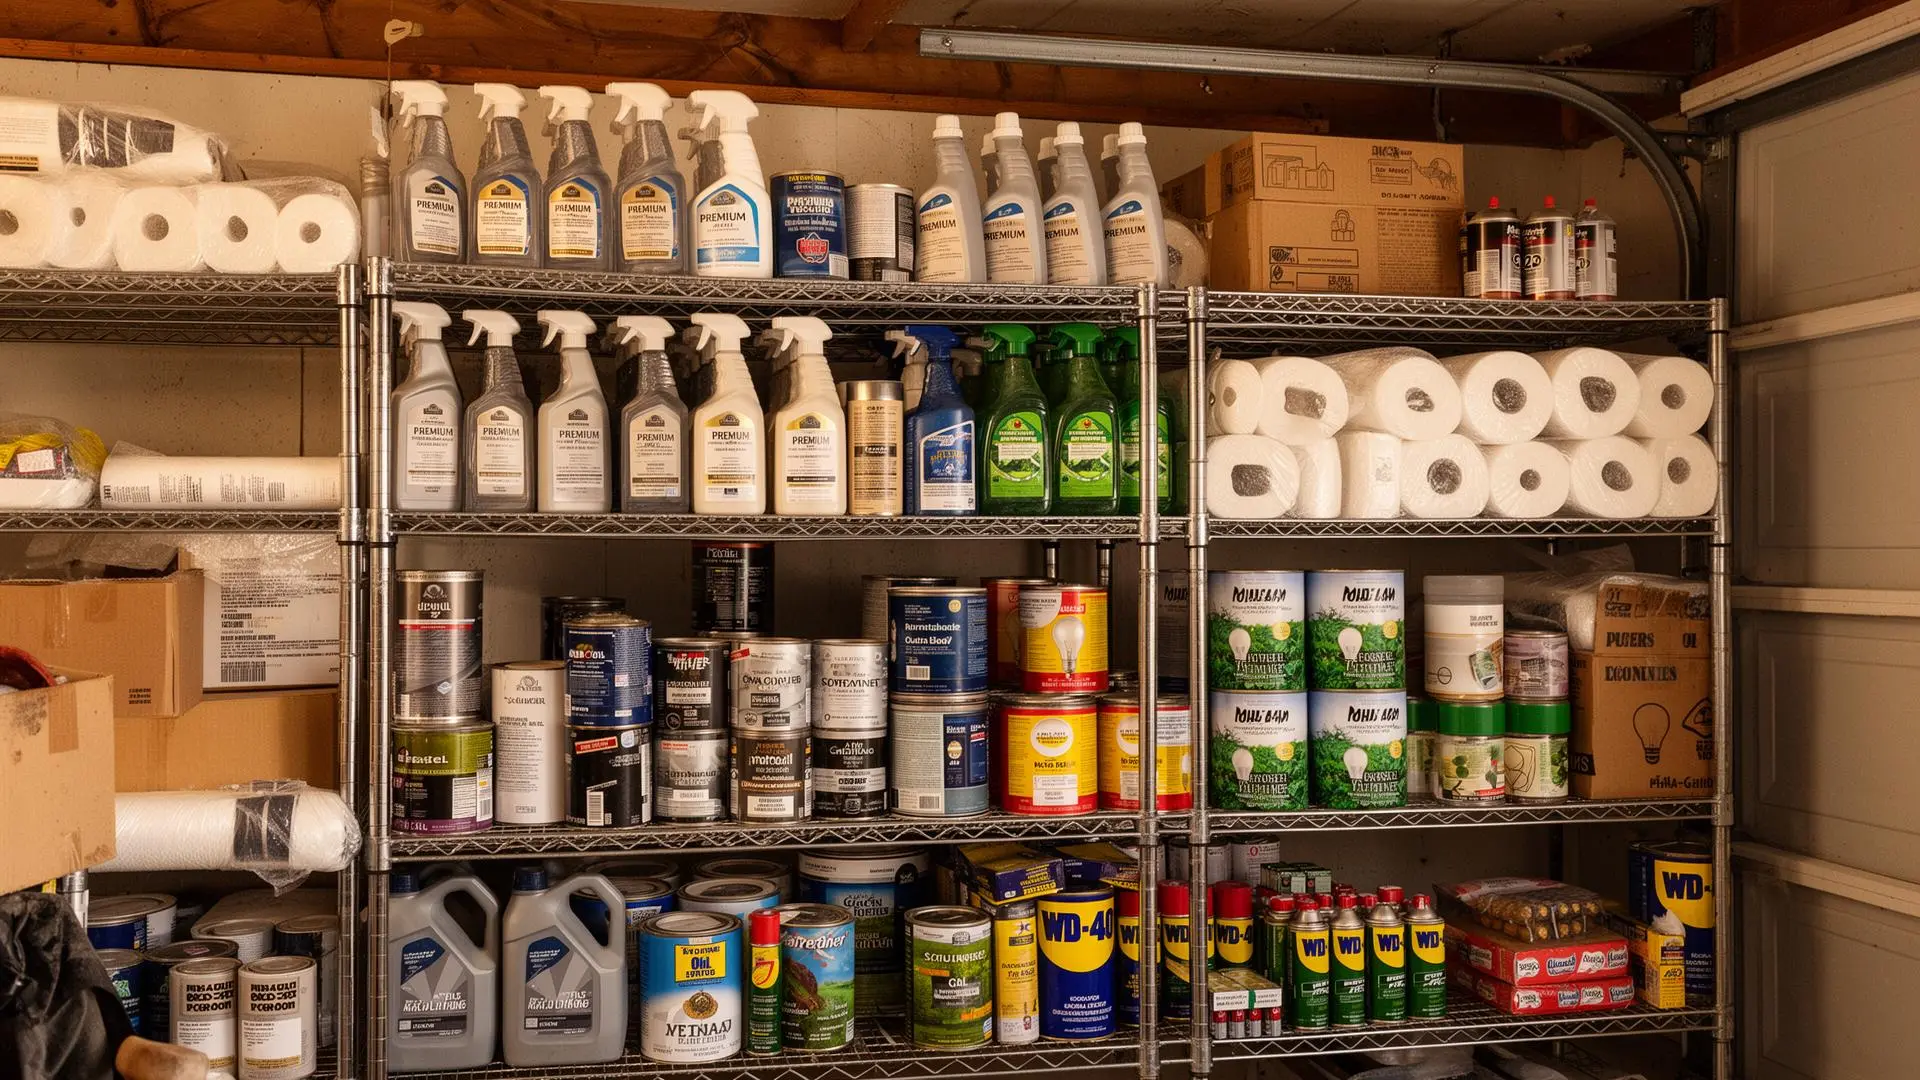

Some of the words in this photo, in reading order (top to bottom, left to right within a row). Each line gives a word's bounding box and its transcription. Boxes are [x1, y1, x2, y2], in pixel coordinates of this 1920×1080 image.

[416, 200, 455, 213] PREMIUM
[555, 204, 591, 212] PREMIUM
[628, 205, 667, 213] PREMIUM
[700, 212, 746, 222] PREMIUM
[919, 219, 957, 232] PREMIUM
[984, 229, 1026, 241] PREMIUM
[1105, 225, 1146, 239] PREMIUM
[413, 426, 453, 437] PREMIUM
[483, 427, 520, 437] PREMIUM
[559, 430, 600, 439] PREMIUM
[636, 433, 675, 442] PREMIUM
[792, 436, 830, 445] PREMIUM
[1041, 907, 1114, 943] WD-40
